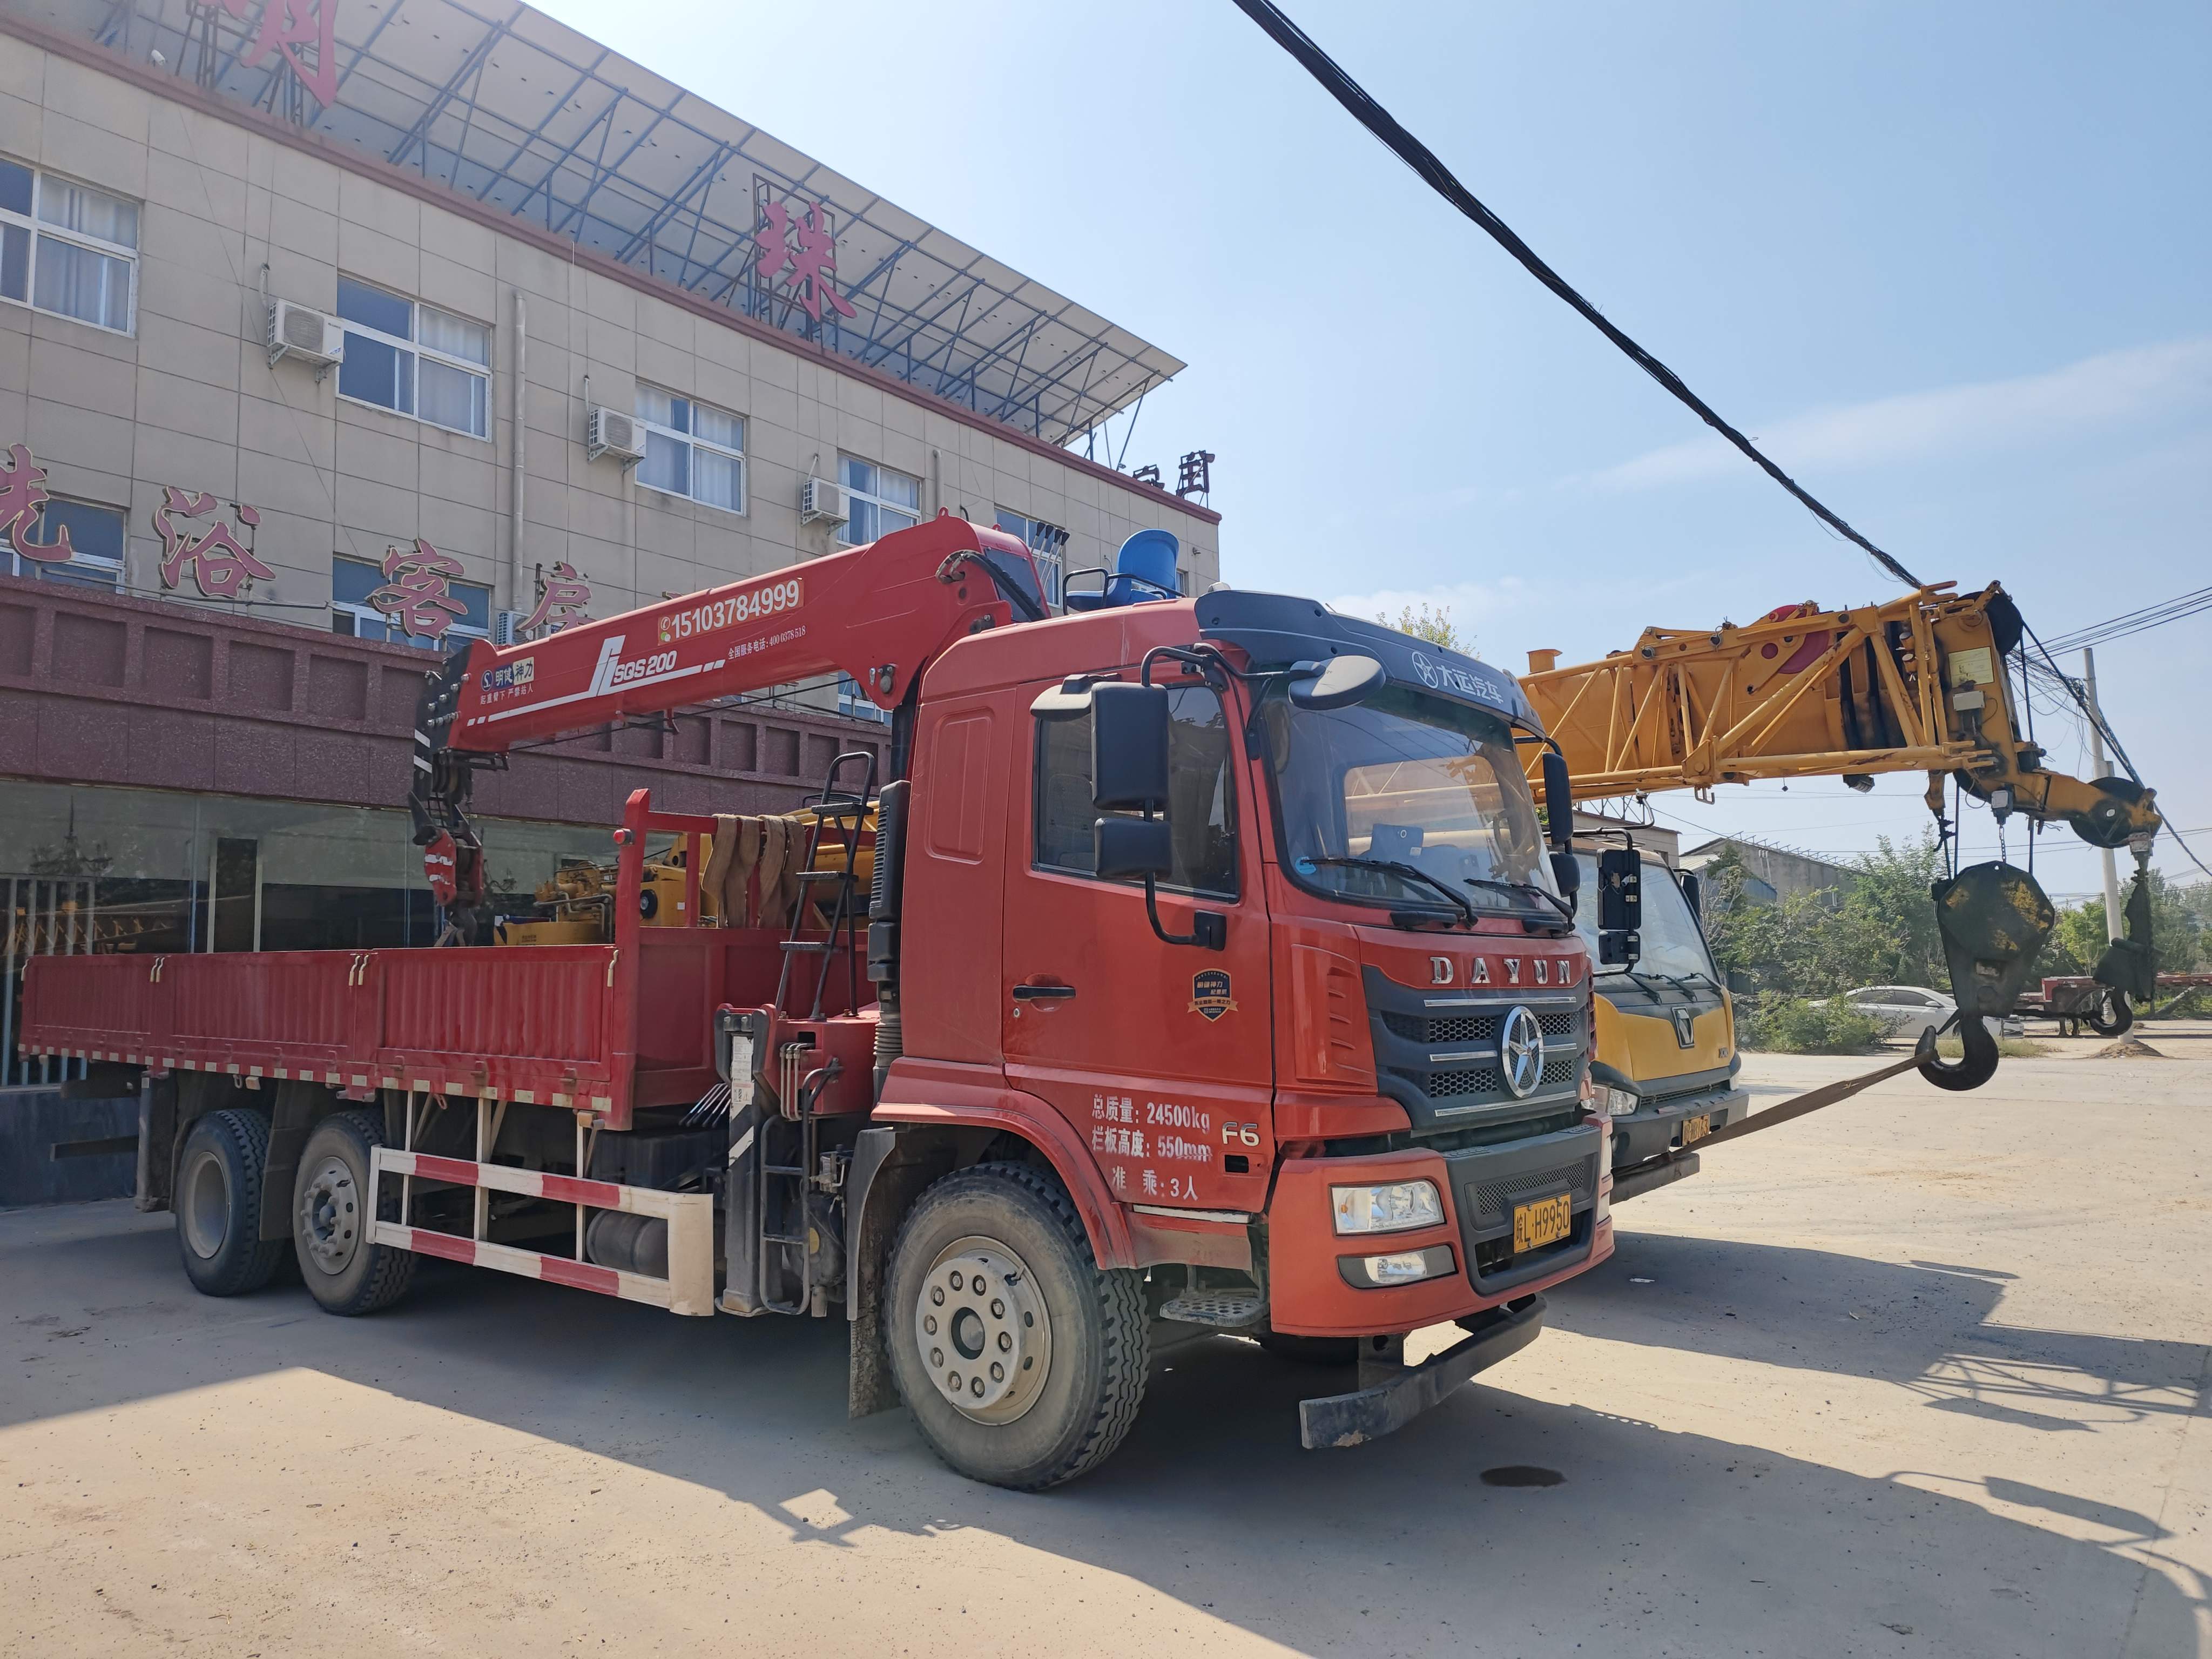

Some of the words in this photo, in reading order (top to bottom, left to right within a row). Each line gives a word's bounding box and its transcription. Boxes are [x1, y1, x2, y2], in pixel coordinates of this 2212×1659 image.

[671, 580, 800, 639] 15103784999
[1435, 665, 1504, 704] 大运汽车
[1429, 956, 1571, 984] DAYUN
[1222, 1122, 1260, 1147] F6
